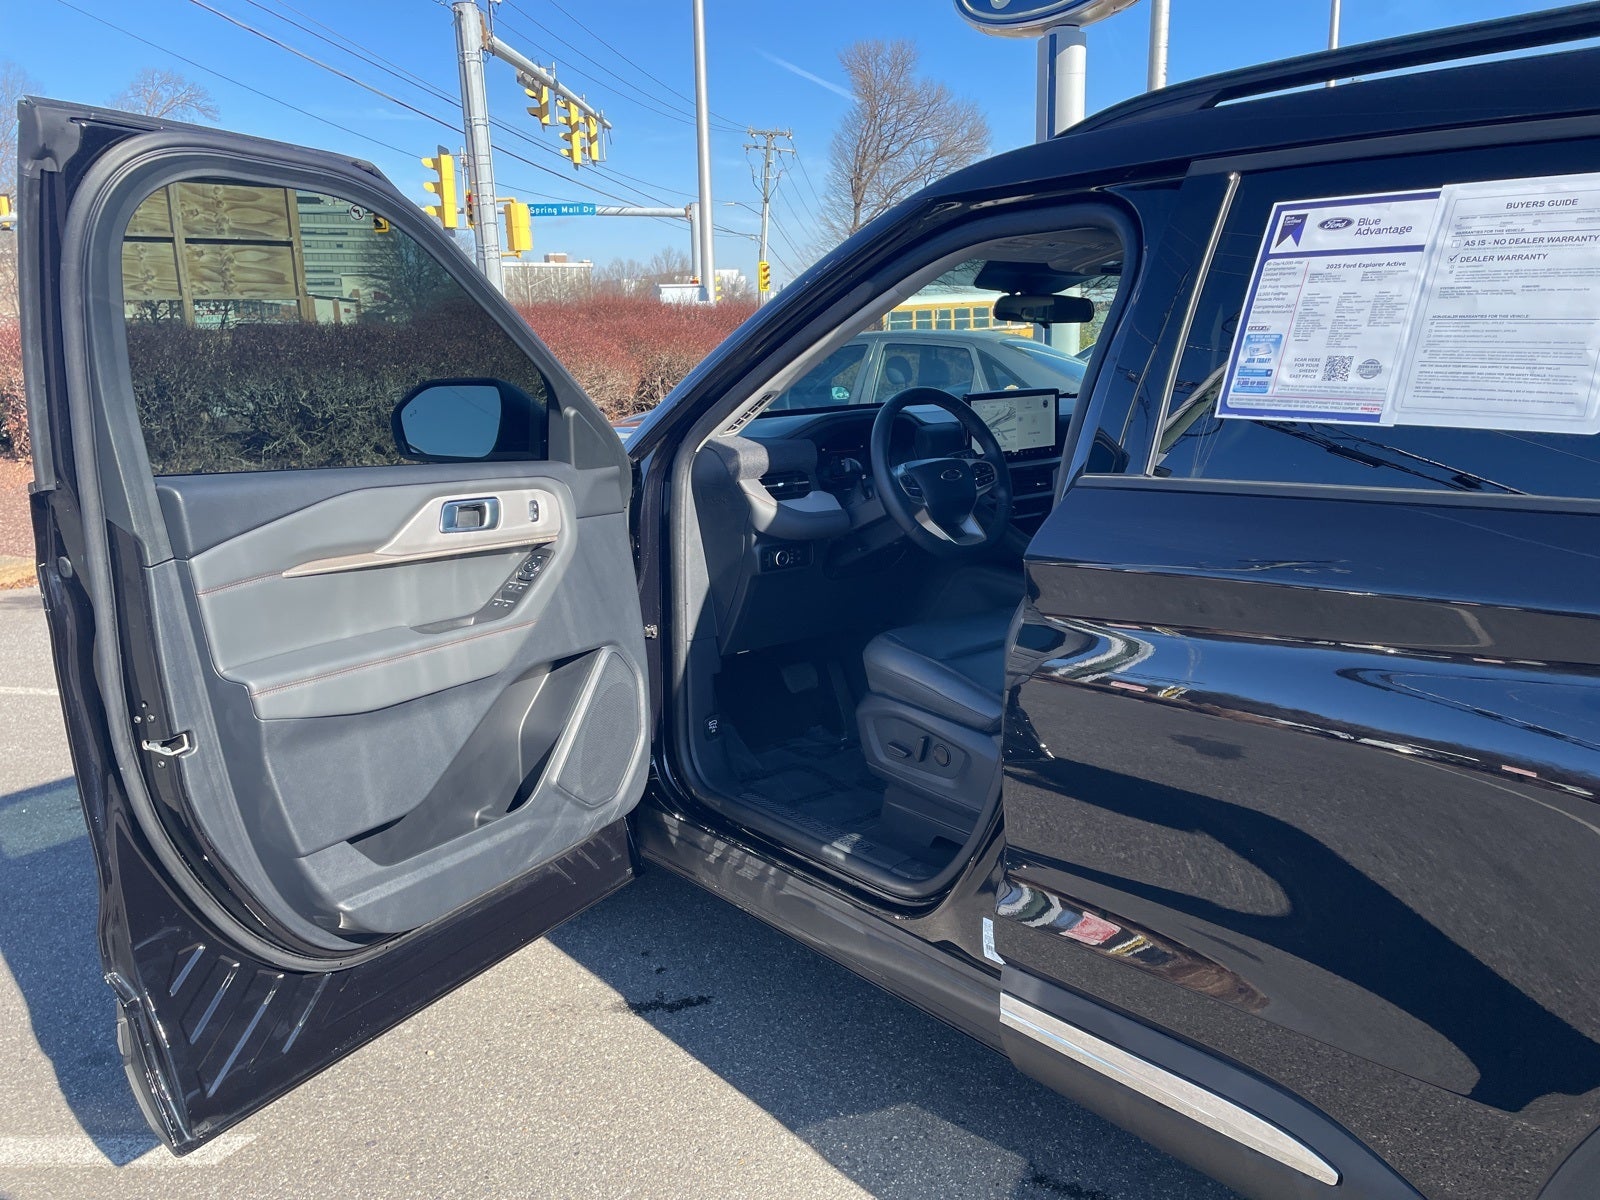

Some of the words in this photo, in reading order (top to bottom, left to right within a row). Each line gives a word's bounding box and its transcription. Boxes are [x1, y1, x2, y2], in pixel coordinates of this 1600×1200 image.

[1506, 200, 1545, 209] BUYERS
[1548, 198, 1579, 207] GUIDE
[530, 206, 557, 215] Spring
[1357, 217, 1381, 227] Blue
[1355, 225, 1413, 236] Advantage
[1493, 238, 1507, 246] NO
[1508, 237, 1545, 245] DEALER
[1547, 235, 1600, 243] WARRANTY
[1459, 254, 1495, 263] DEALER
[1496, 253, 1549, 261] WARRANTY
[1358, 262, 1385, 270] Explorer
